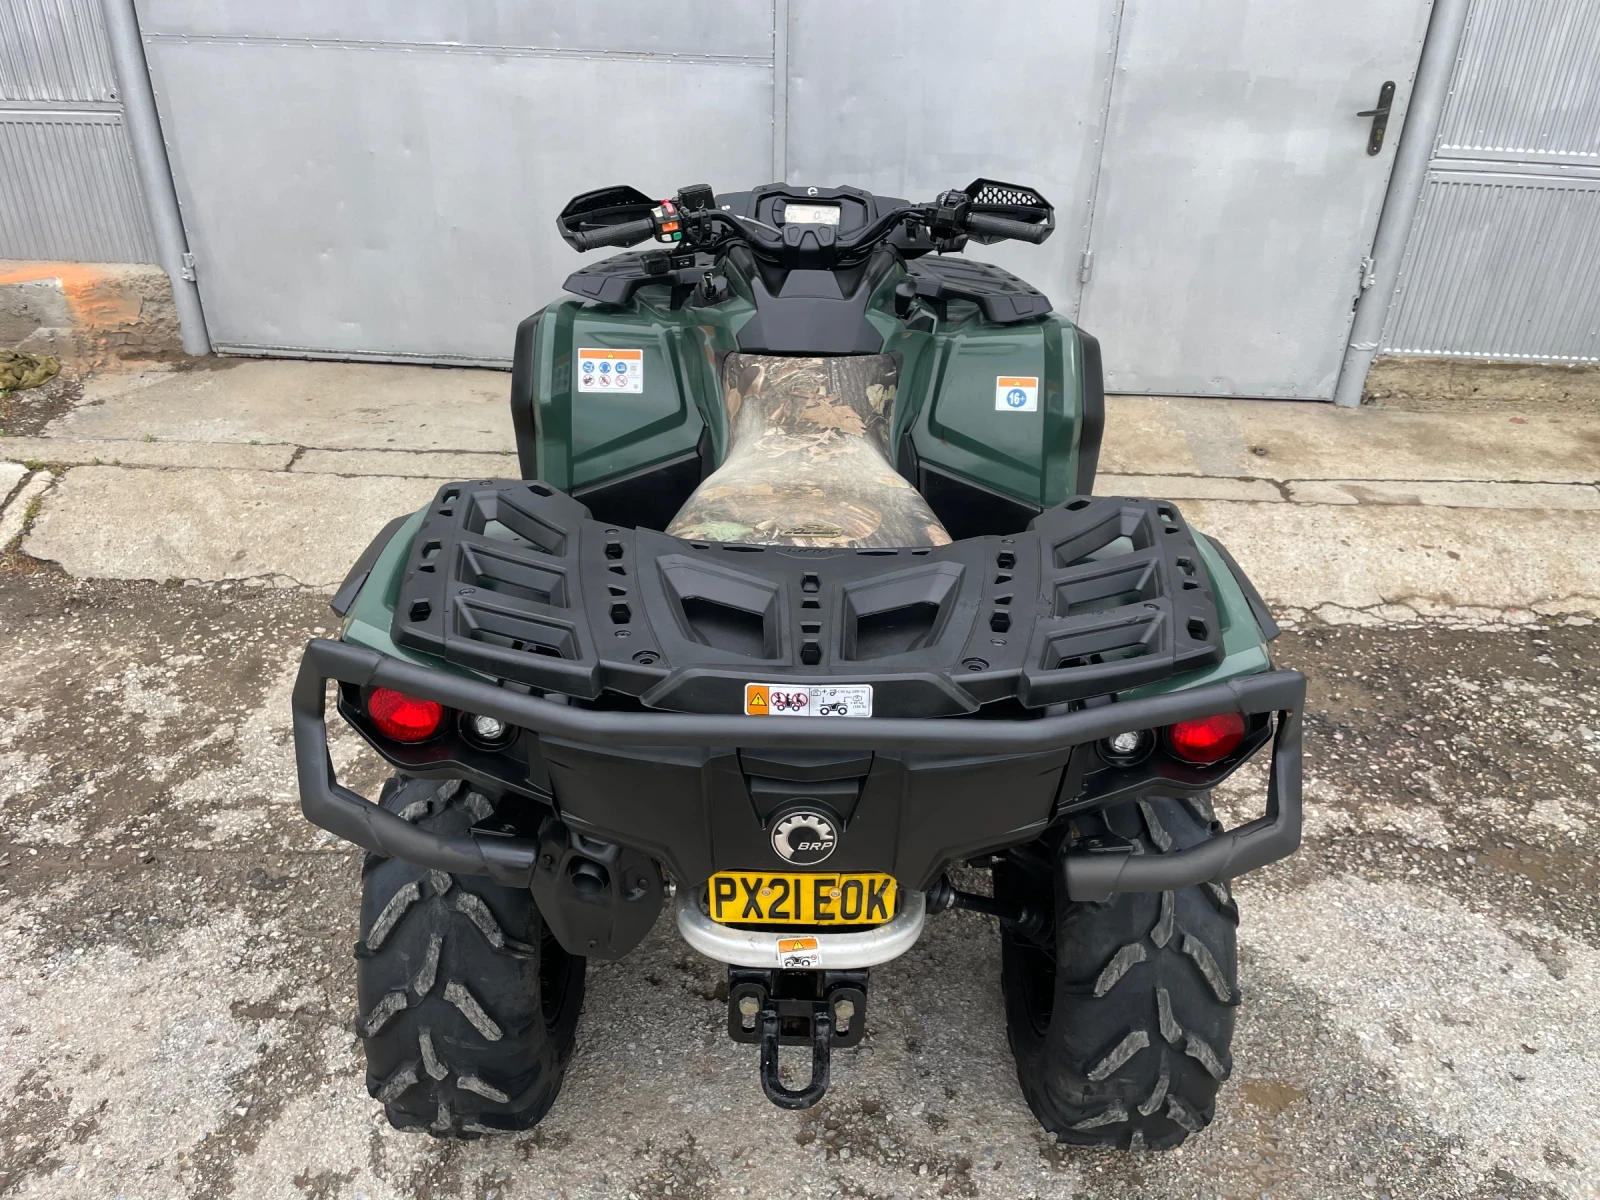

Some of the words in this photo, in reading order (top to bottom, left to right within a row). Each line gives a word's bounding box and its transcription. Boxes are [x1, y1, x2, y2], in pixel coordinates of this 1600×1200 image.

[1008, 392, 1025, 405] 16+
[797, 842, 833, 851] BRP
[714, 877, 801, 920] PX21
[813, 878, 891, 921] EOK
